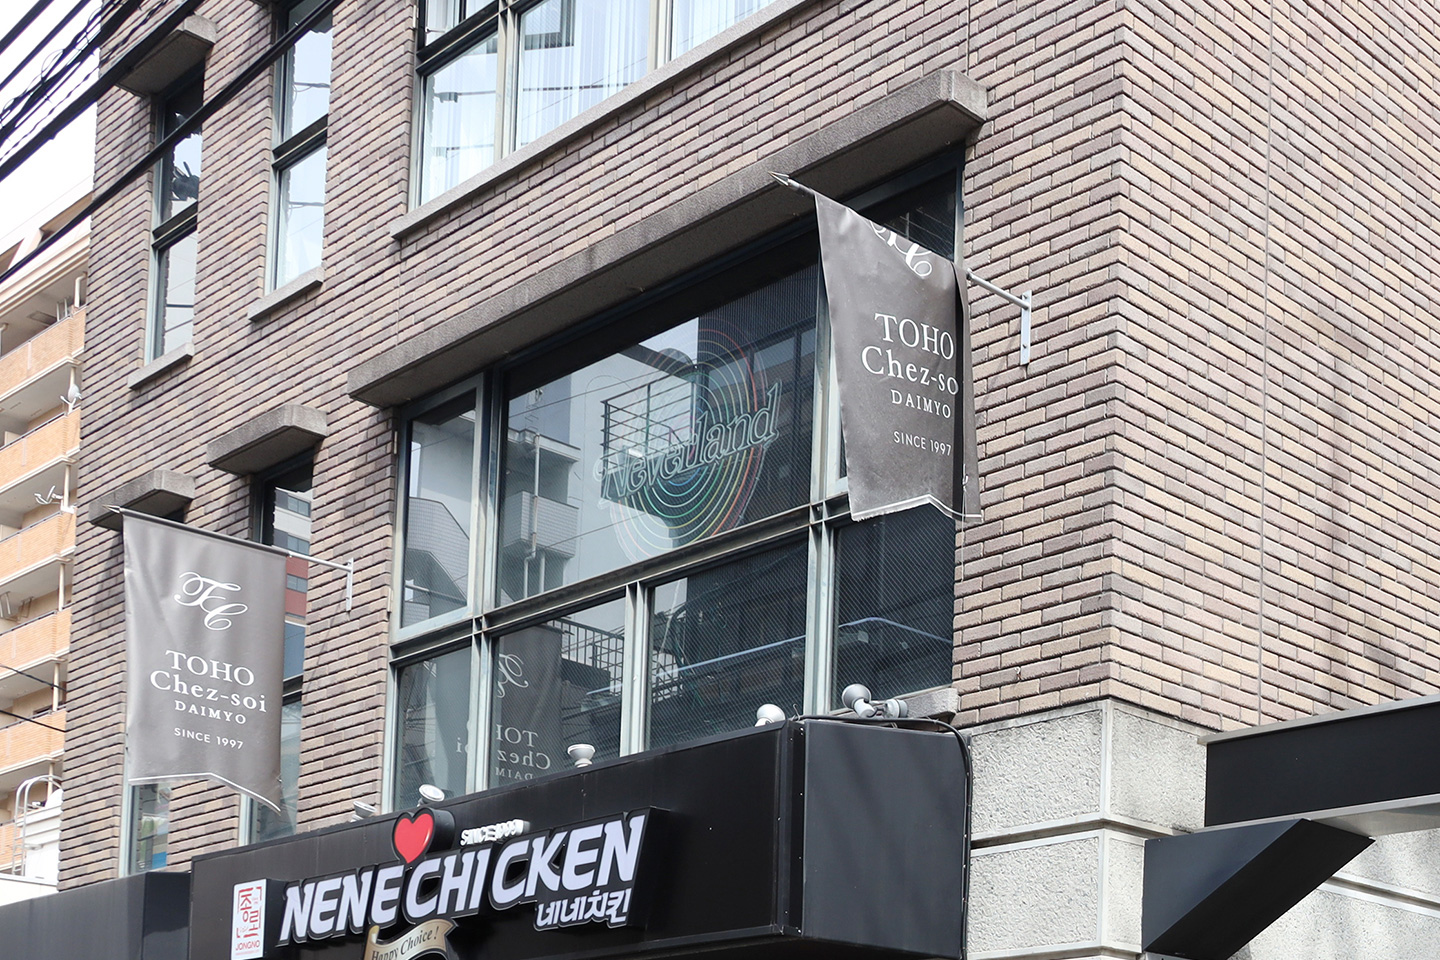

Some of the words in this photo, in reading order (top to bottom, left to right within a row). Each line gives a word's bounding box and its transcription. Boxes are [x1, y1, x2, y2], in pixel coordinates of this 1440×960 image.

[874, 312, 954, 361] TOHO
[890, 389, 952, 419] DAIMYO
[893, 431, 927, 450] SINCE
[930, 439, 952, 457] 1997
[165, 649, 255, 687] TOHO
[150, 670, 267, 713] Chez-soi
[174, 700, 247, 725] DAIMYO
[174, 727, 211, 744] SINCE
[216, 736, 244, 750] 1997
[279, 864, 405, 942] NENE
[405, 814, 646, 919] CHICKEN
[536, 888, 632, 927] 네네치킨
[235, 940, 260, 951] JONGNO
